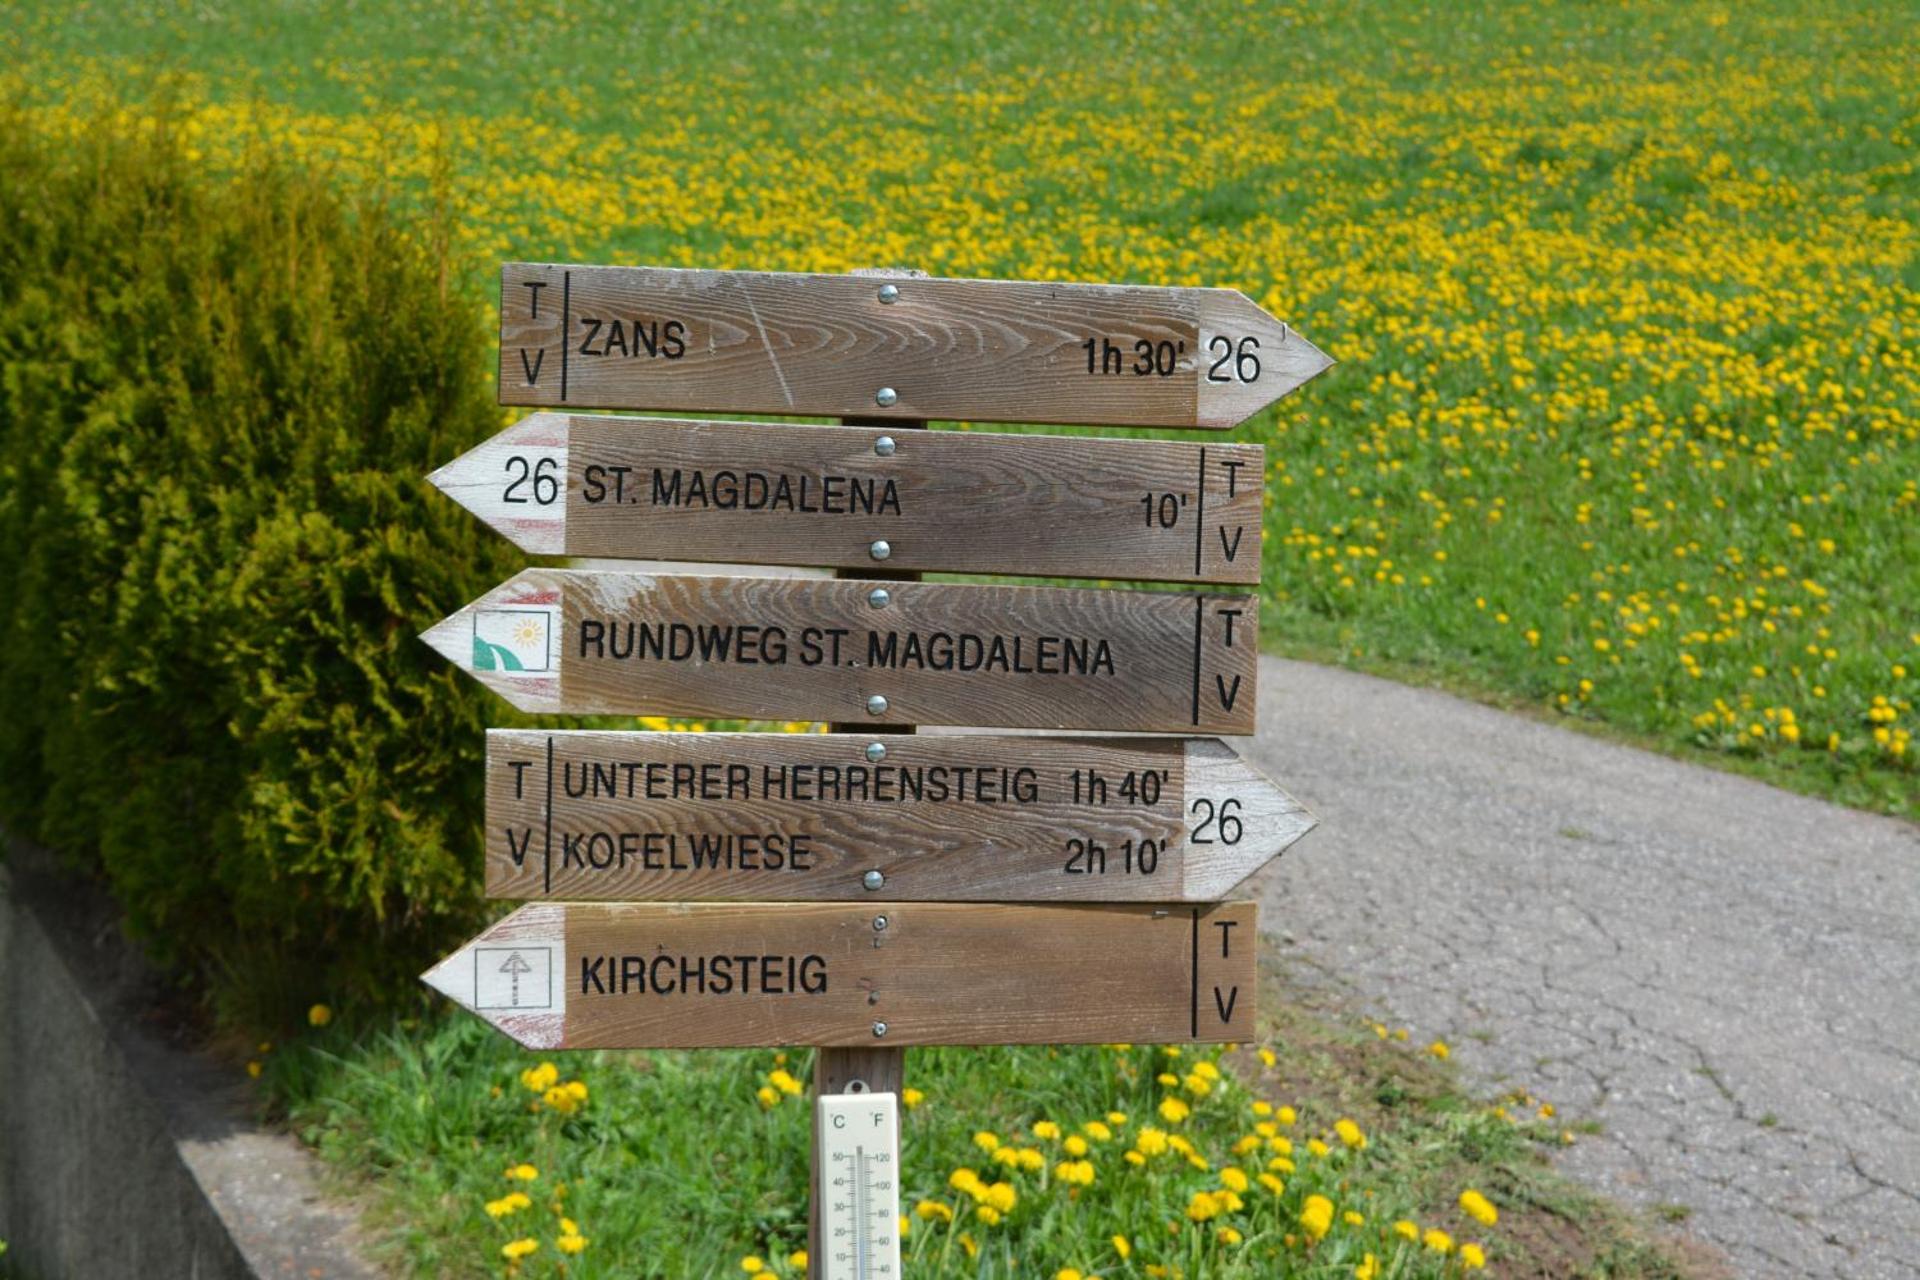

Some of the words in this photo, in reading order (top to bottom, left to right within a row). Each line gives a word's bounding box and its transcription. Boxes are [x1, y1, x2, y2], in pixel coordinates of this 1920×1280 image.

[523, 282, 547, 319] T
[579, 318, 686, 360] ZANS
[1082, 337, 1121, 375] 1h
[1133, 339, 1185, 376] 30'
[520, 349, 543, 385] V
[1207, 336, 1261, 384] 26
[503, 455, 558, 505] 26
[583, 465, 636, 505] ST.
[652, 469, 902, 516] MAGDALENA
[1221, 461, 1245, 498] T
[1140, 492, 1187, 529] 10'
[1219, 526, 1242, 563] V
[1218, 609, 1242, 646] T
[580, 620, 787, 666] RUNDWEG
[799, 628, 853, 667] ST.
[867, 631, 1116, 677] MAGDALENA
[1216, 674, 1241, 712] V
[508, 761, 532, 800] T
[564, 762, 749, 800] UNTERER
[764, 765, 1039, 804] HERRENSTEIG
[1067, 769, 1107, 805] 1h
[1118, 770, 1169, 806] 40'
[1191, 798, 1243, 845] 26
[506, 828, 531, 866] V
[562, 832, 811, 871] KOFELWIESE
[1064, 839, 1106, 874] 2h
[1120, 839, 1166, 875] 10'
[1214, 921, 1238, 959] T
[581, 954, 828, 995] KIRCHSTEIG
[1214, 986, 1237, 1024] V
[833, 1152, 844, 1162] 50
[875, 1153, 890, 1162] 120
[833, 1176, 844, 1186] 40
[876, 1182, 891, 1190] 100
[834, 1202, 845, 1212] 30
[878, 1210, 889, 1218] 80
[834, 1227, 845, 1236] 20
[878, 1237, 889, 1246] 60
[836, 1253, 846, 1261] 10
[879, 1265, 890, 1274] 40
